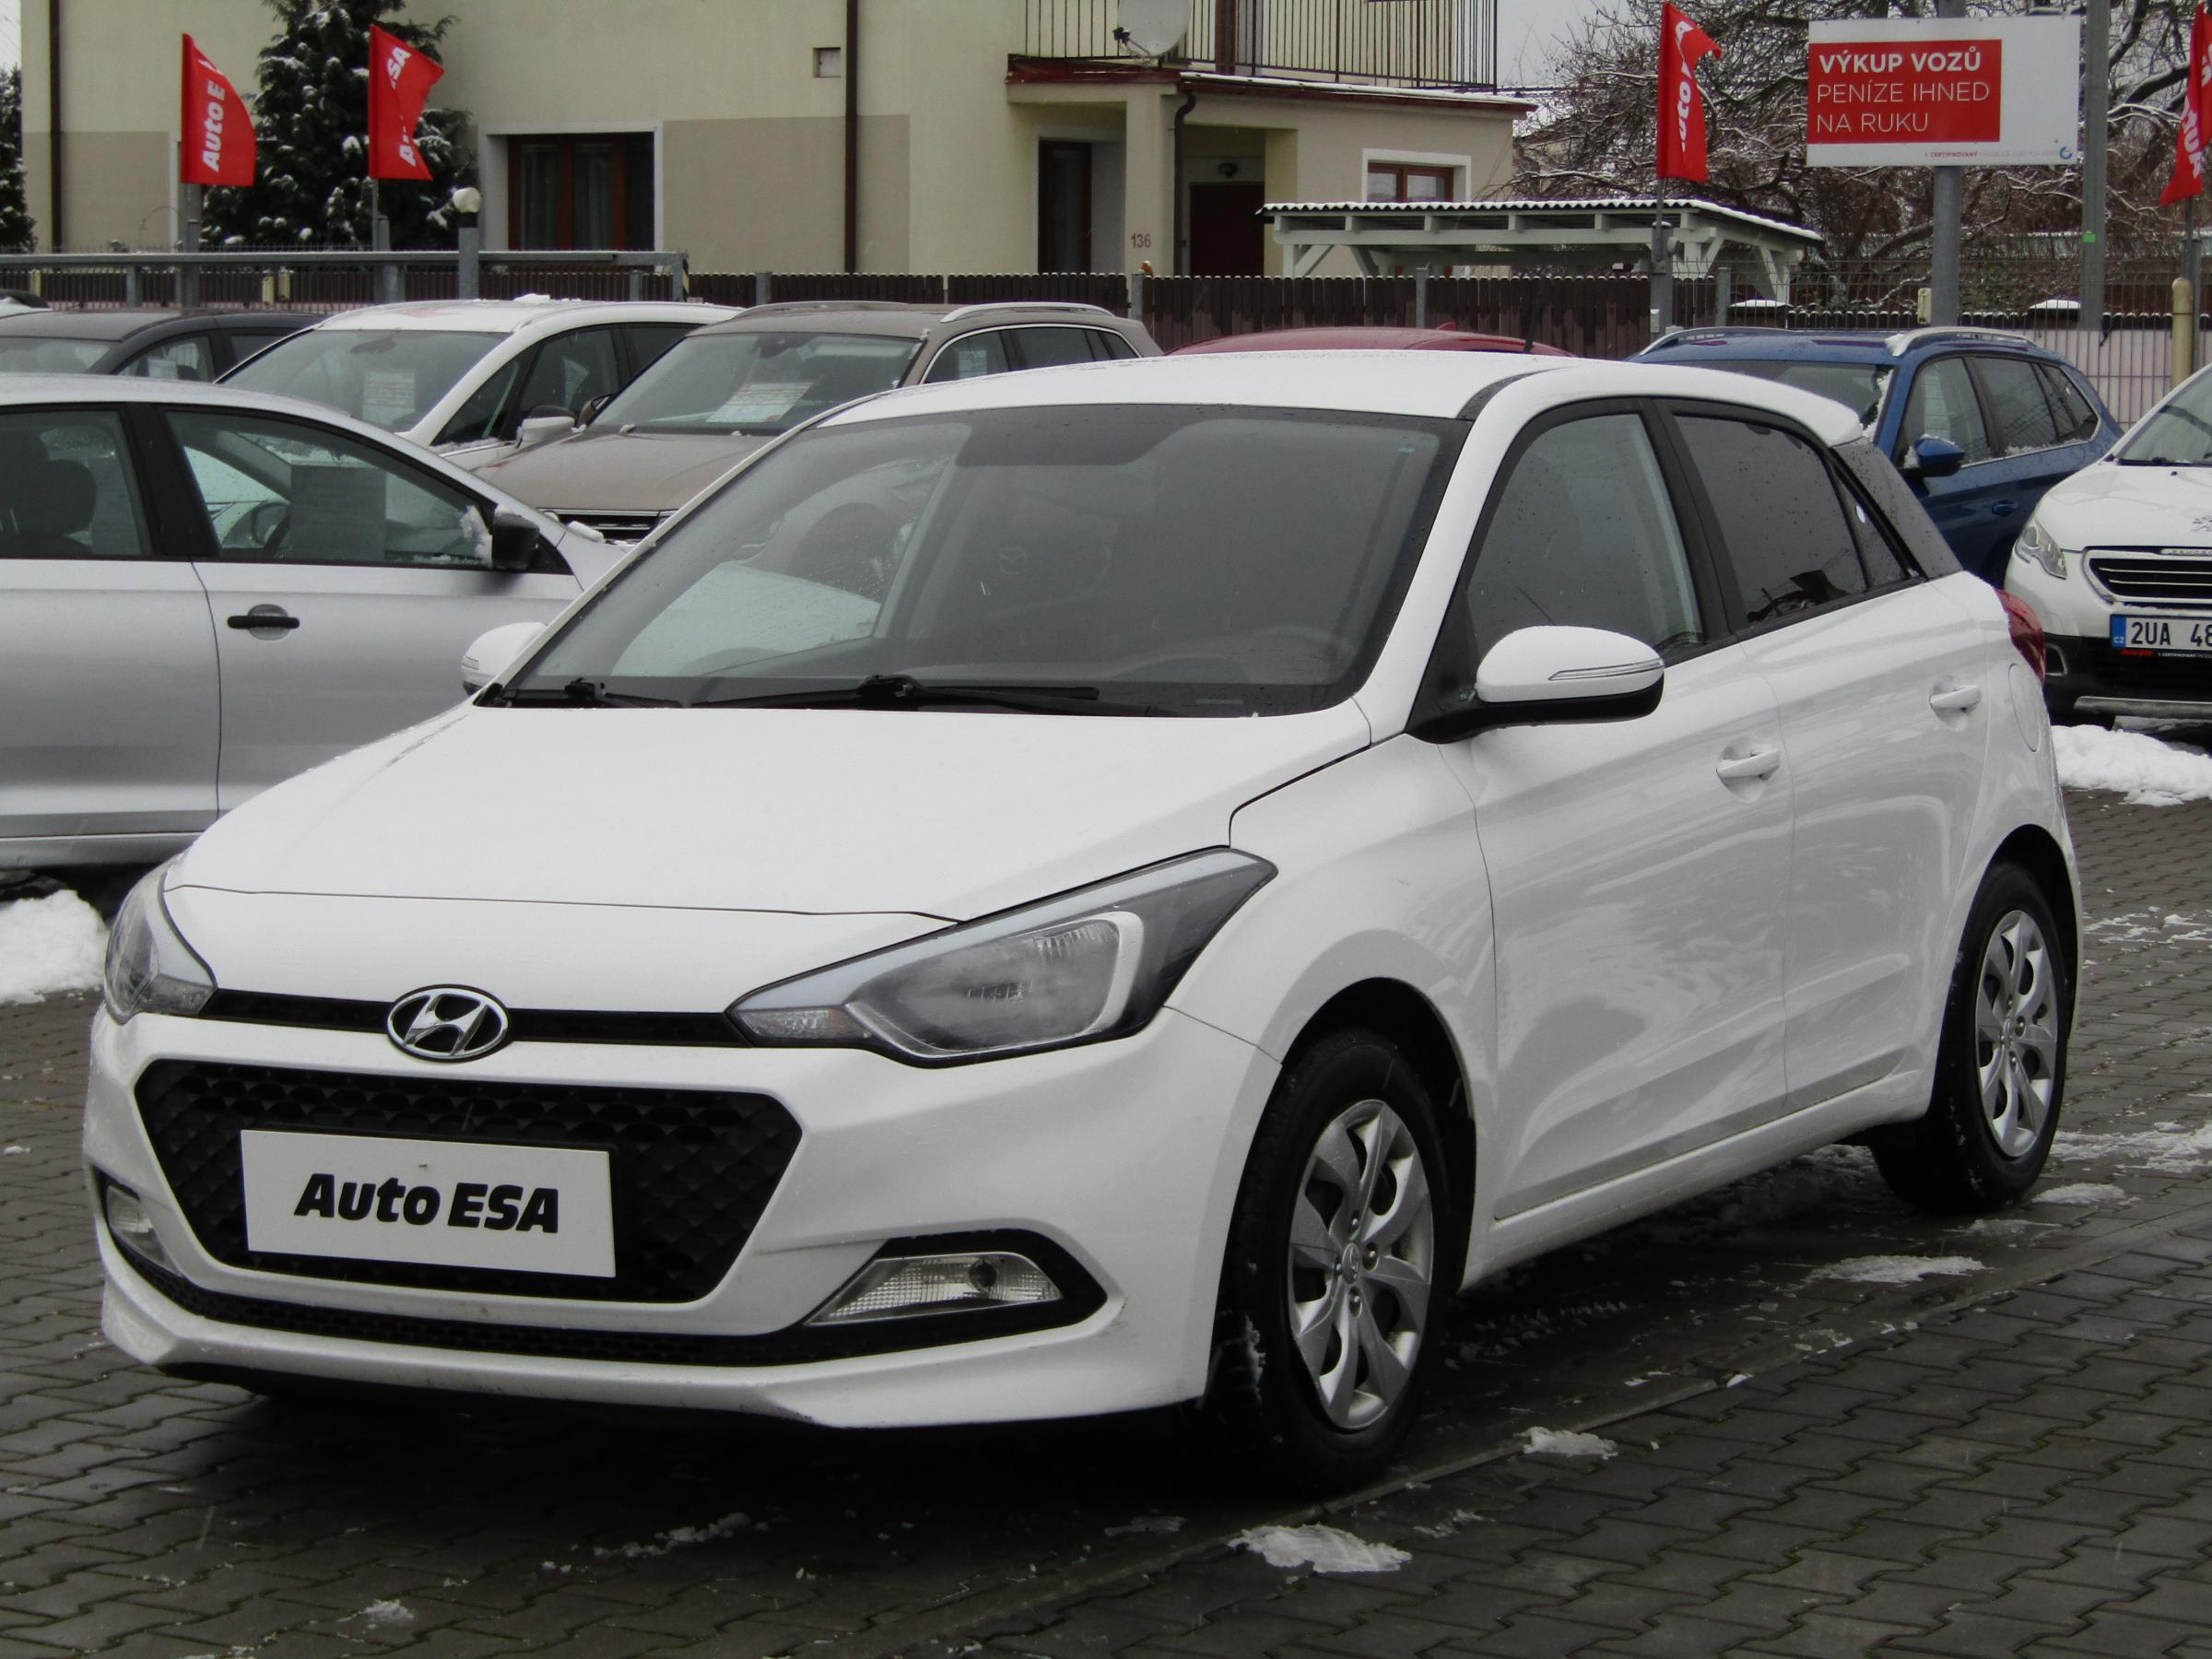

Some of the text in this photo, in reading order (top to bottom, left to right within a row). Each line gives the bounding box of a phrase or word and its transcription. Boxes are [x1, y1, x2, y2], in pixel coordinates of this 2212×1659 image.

[384, 47, 411, 89] SA
[1819, 46, 1981, 74] VÝKUP VOZŮ
[1818, 80, 1990, 103] PENÍZE IHNED
[203, 99, 224, 172] Auto
[1817, 112, 1928, 133] NA RUKU
[1131, 233, 1151, 249] 136
[2131, 621, 2171, 645] 2UA
[293, 1172, 559, 1233] Auto ESA
